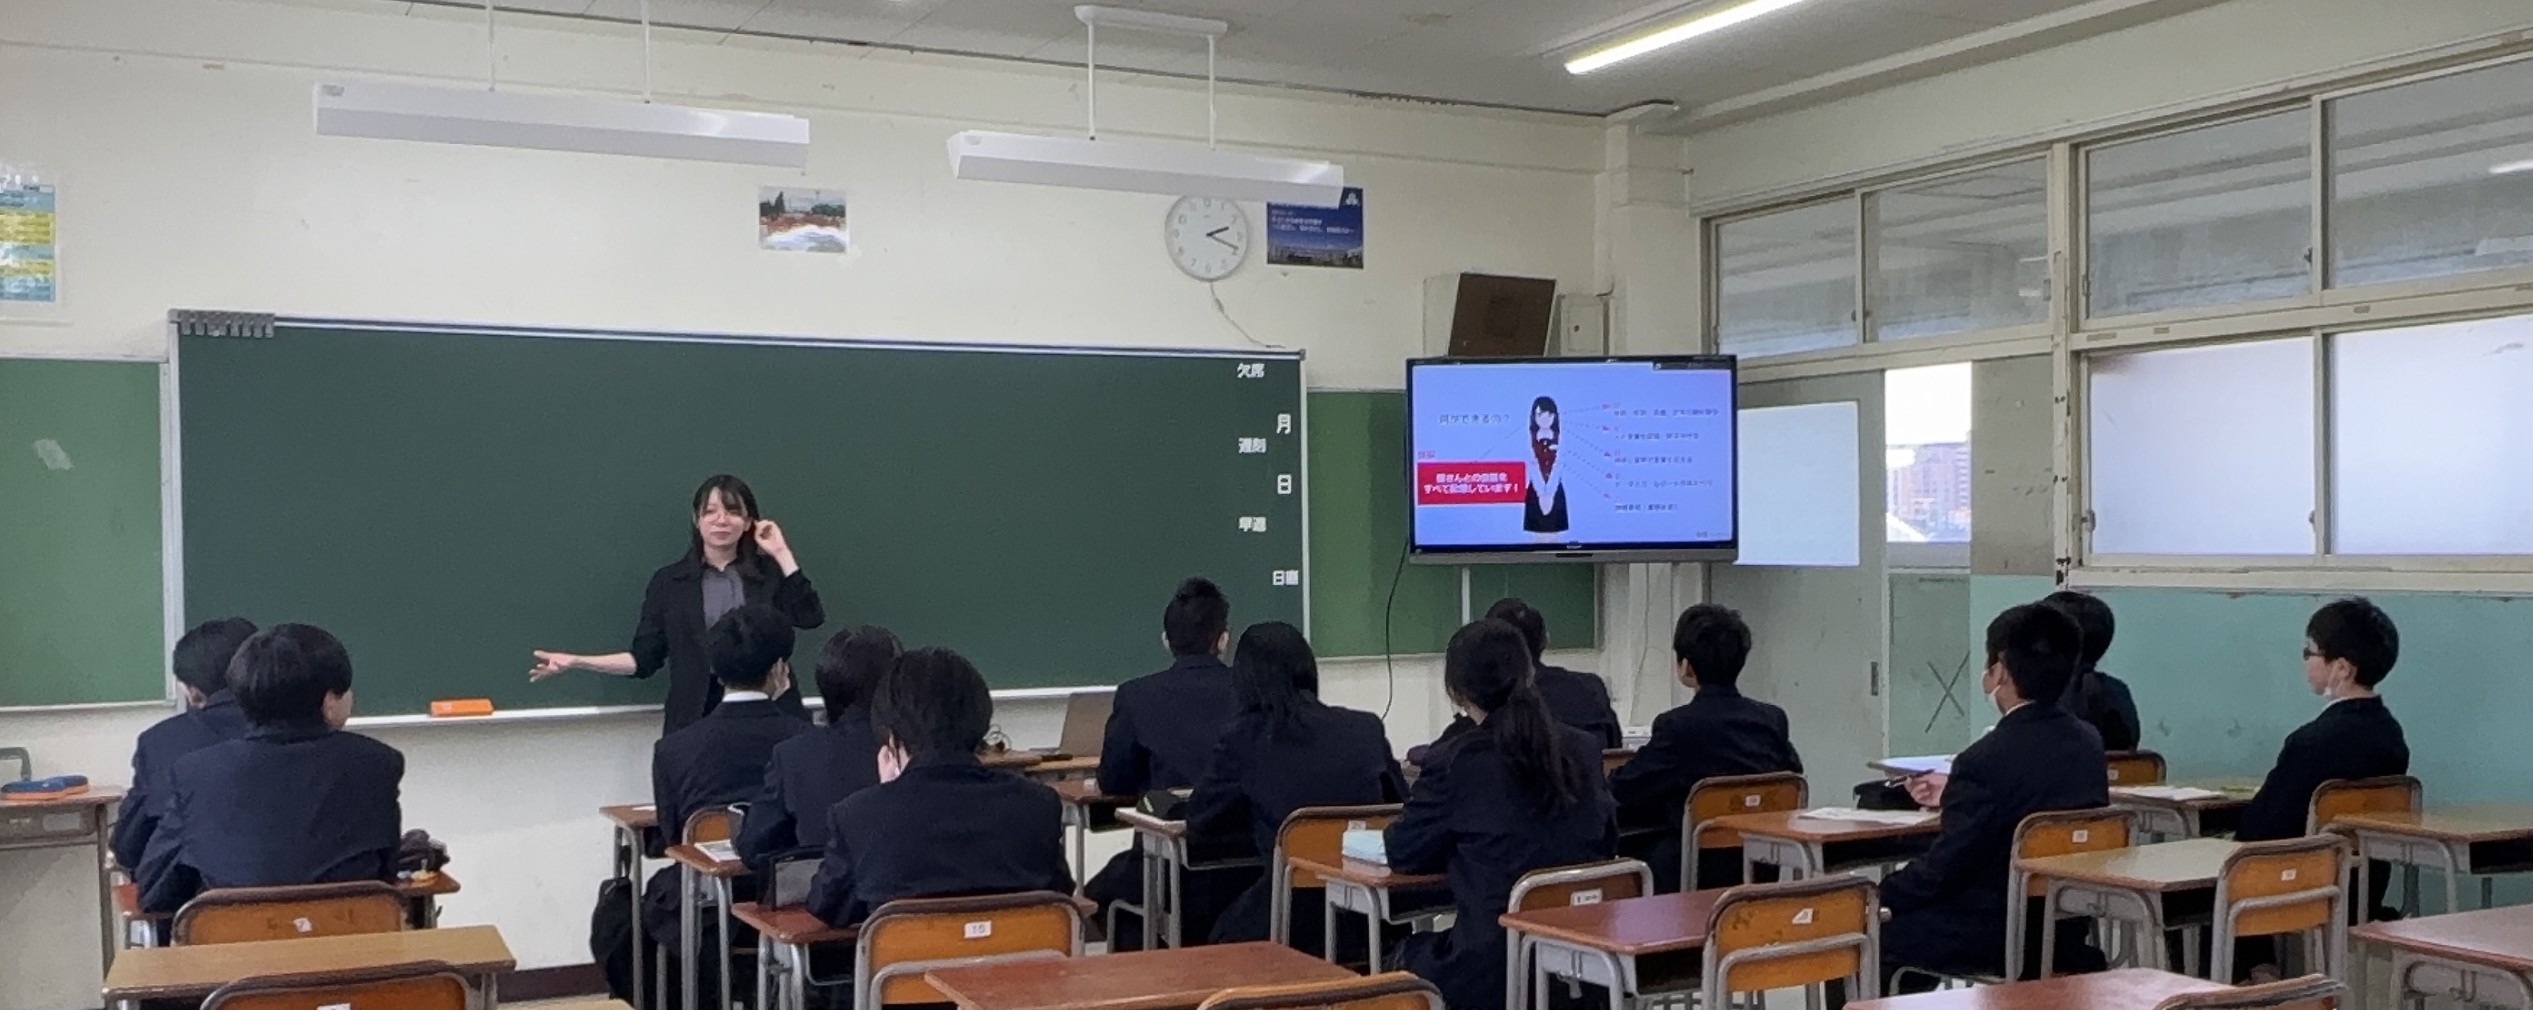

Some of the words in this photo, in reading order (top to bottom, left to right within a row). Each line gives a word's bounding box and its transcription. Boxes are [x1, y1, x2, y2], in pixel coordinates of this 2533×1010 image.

[1237, 363, 1265, 378] 欠席
[1276, 413, 1292, 434] 月
[1277, 474, 1292, 494] 日
